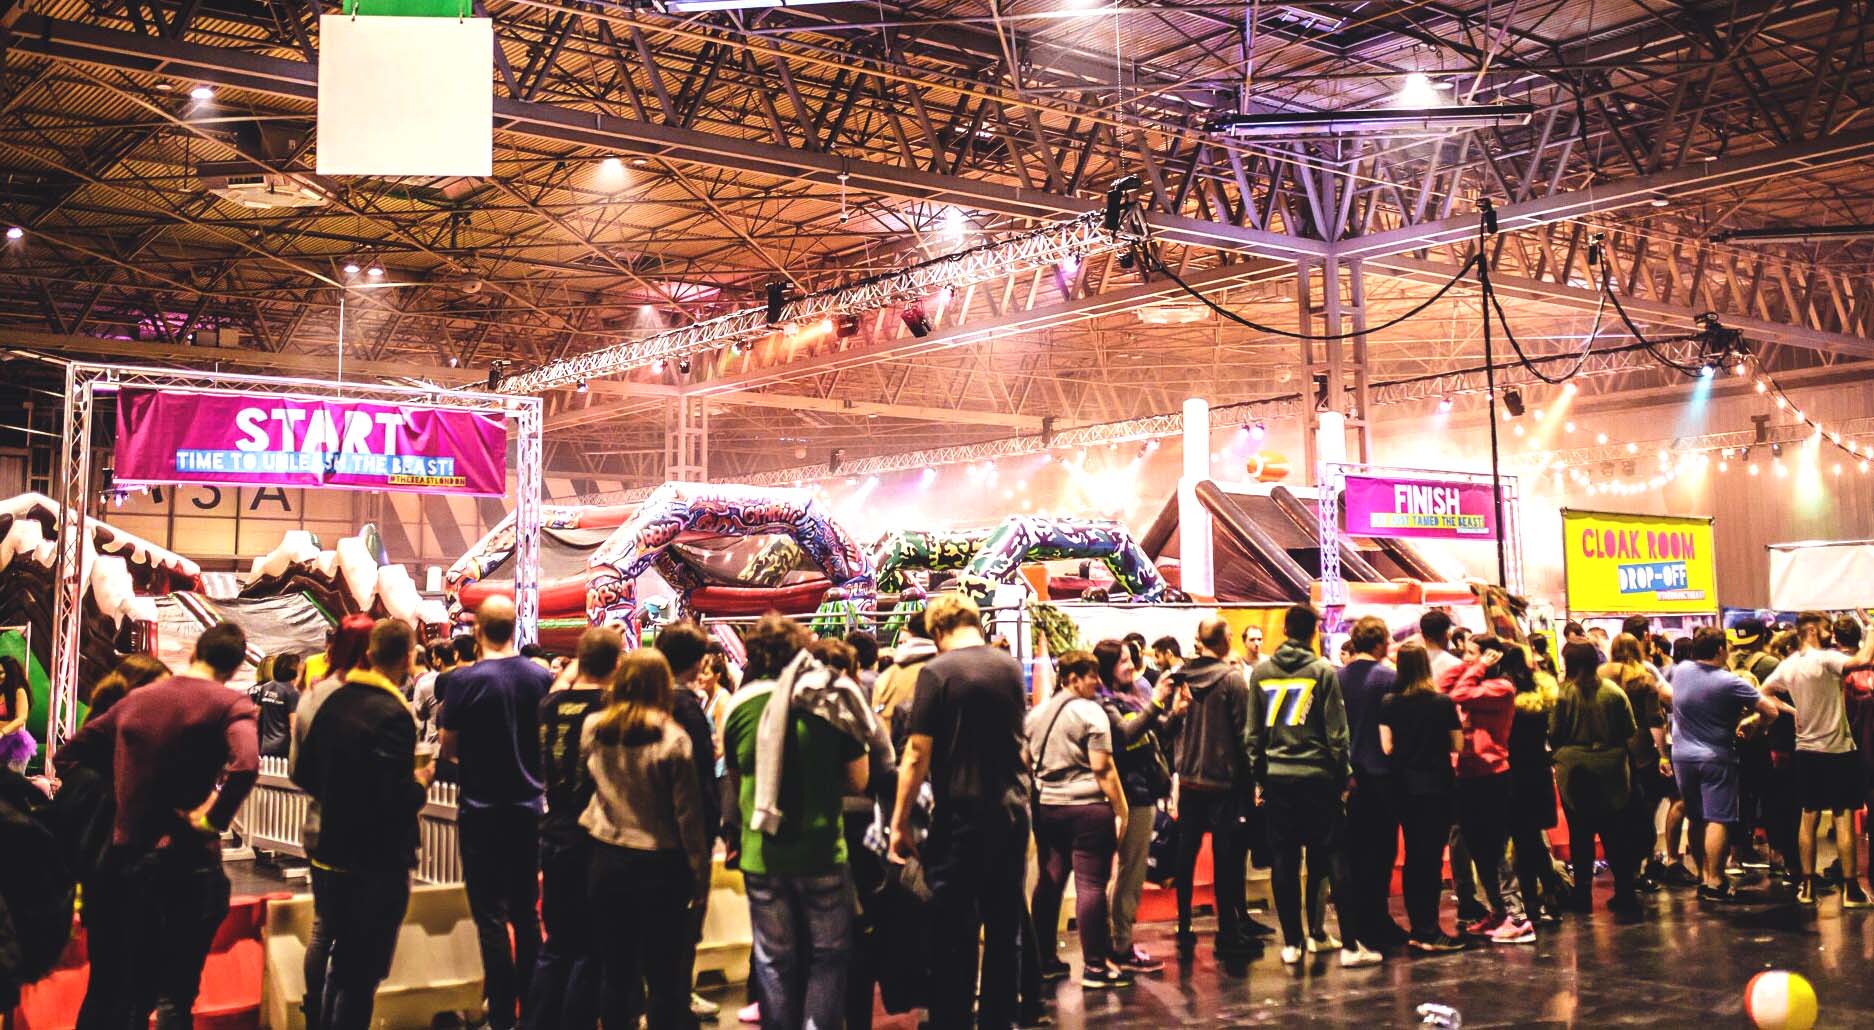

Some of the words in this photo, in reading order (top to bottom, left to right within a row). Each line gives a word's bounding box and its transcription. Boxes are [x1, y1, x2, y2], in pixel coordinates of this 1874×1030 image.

[235, 406, 406, 455] START
[176, 451, 225, 470] TIME
[230, 452, 257, 470] TO
[262, 452, 347, 472] UNLESH
[353, 454, 387, 473] THE
[391, 455, 454, 476] BEAST!
[1394, 484, 1460, 515] FINISH
[1411, 515, 1439, 527] TAMED
[1441, 516, 1456, 527] THE
[1458, 516, 1484, 528] BEAST
[1582, 528, 1641, 559] CLOAK
[1646, 530, 1696, 560] ROOM
[1618, 563, 1687, 591] DROP-OFF
[1258, 677, 1317, 728] 77
